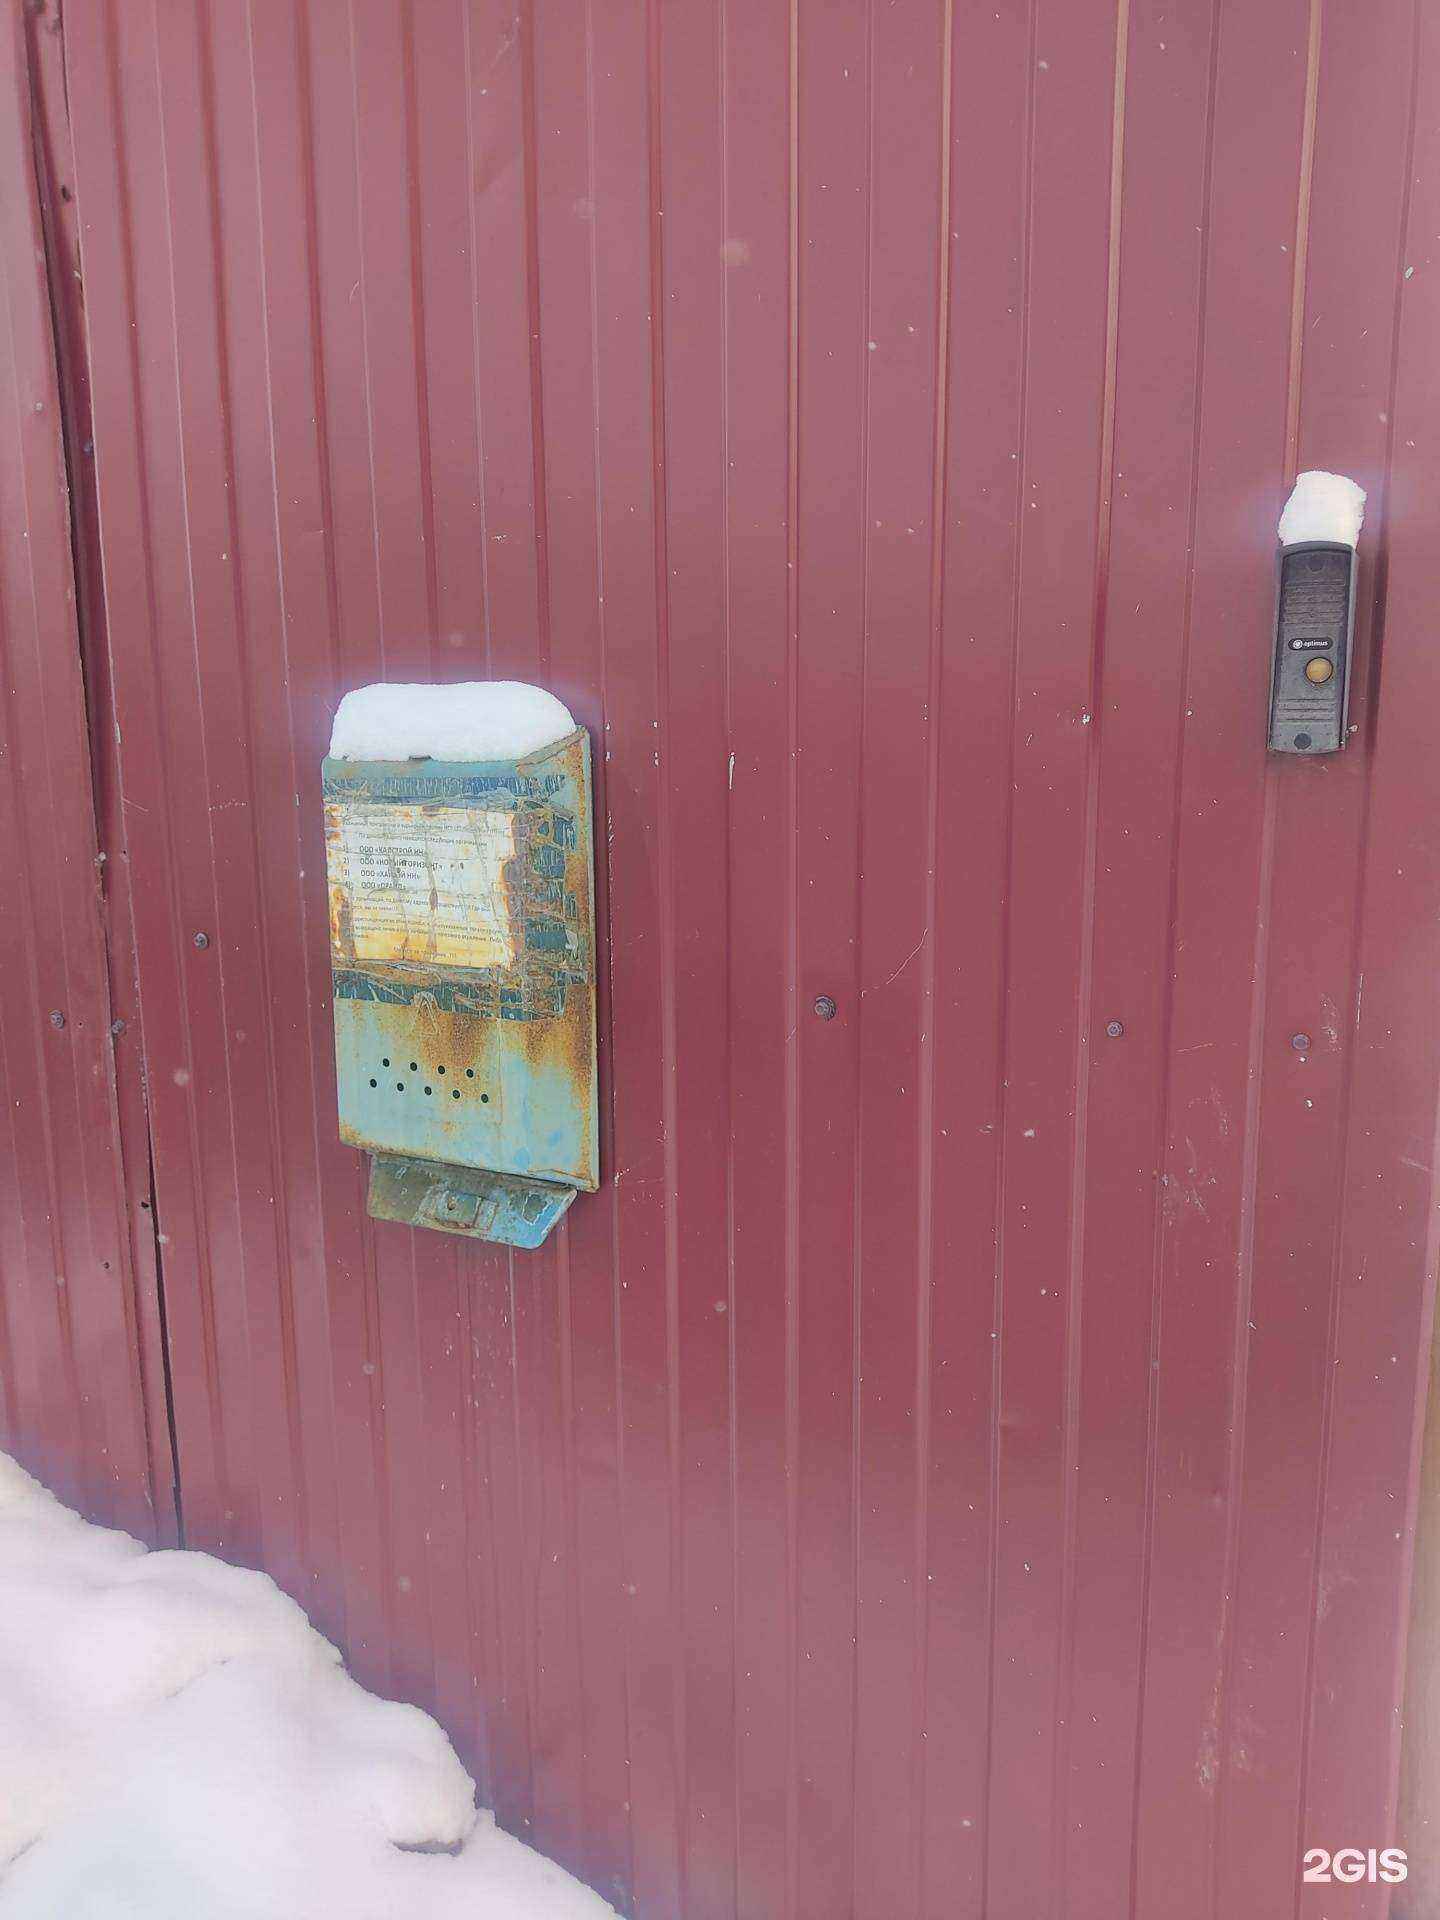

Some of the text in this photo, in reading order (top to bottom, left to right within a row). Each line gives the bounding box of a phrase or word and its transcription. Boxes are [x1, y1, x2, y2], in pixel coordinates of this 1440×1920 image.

[1303, 640, 1329, 648] optimus
[360, 869, 376, 877] ООО
[361, 881, 376, 889] ООО
